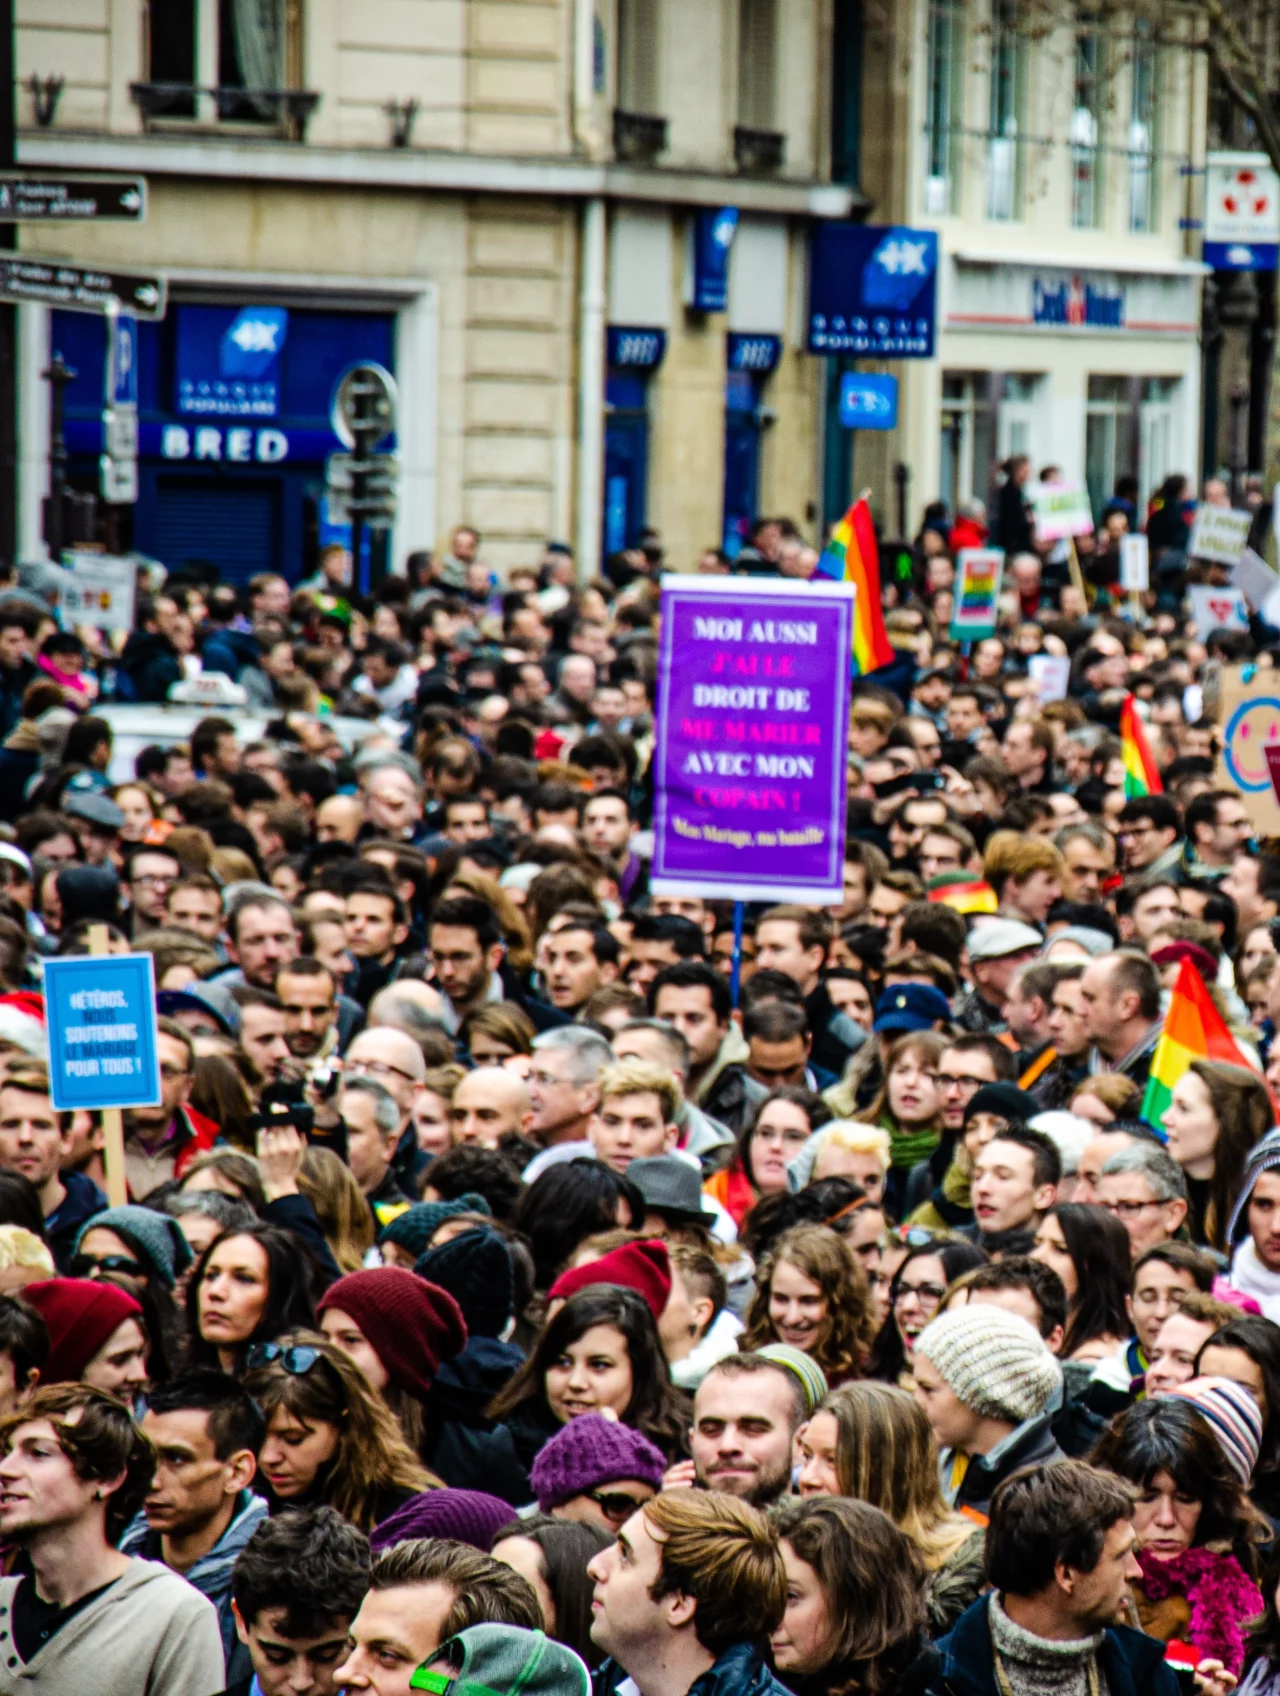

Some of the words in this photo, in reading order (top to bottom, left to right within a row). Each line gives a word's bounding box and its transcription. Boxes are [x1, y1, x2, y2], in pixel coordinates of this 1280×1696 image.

[161, 422, 290, 463] BRED
[692, 615, 743, 642] MOI
[748, 620, 818, 645] AUSSI
[761, 655, 796, 677] LE
[692, 683, 773, 711] DROIT
[775, 686, 811, 712] DE
[680, 717, 716, 740] ME
[724, 720, 822, 746] MARIER
[683, 752, 752, 778] AVEC
[754, 754, 816, 780] MON
[694, 784, 787, 812] COPAIN
[65, 1058, 100, 1078] POUR
[101, 1056, 134, 1076] TOUS
